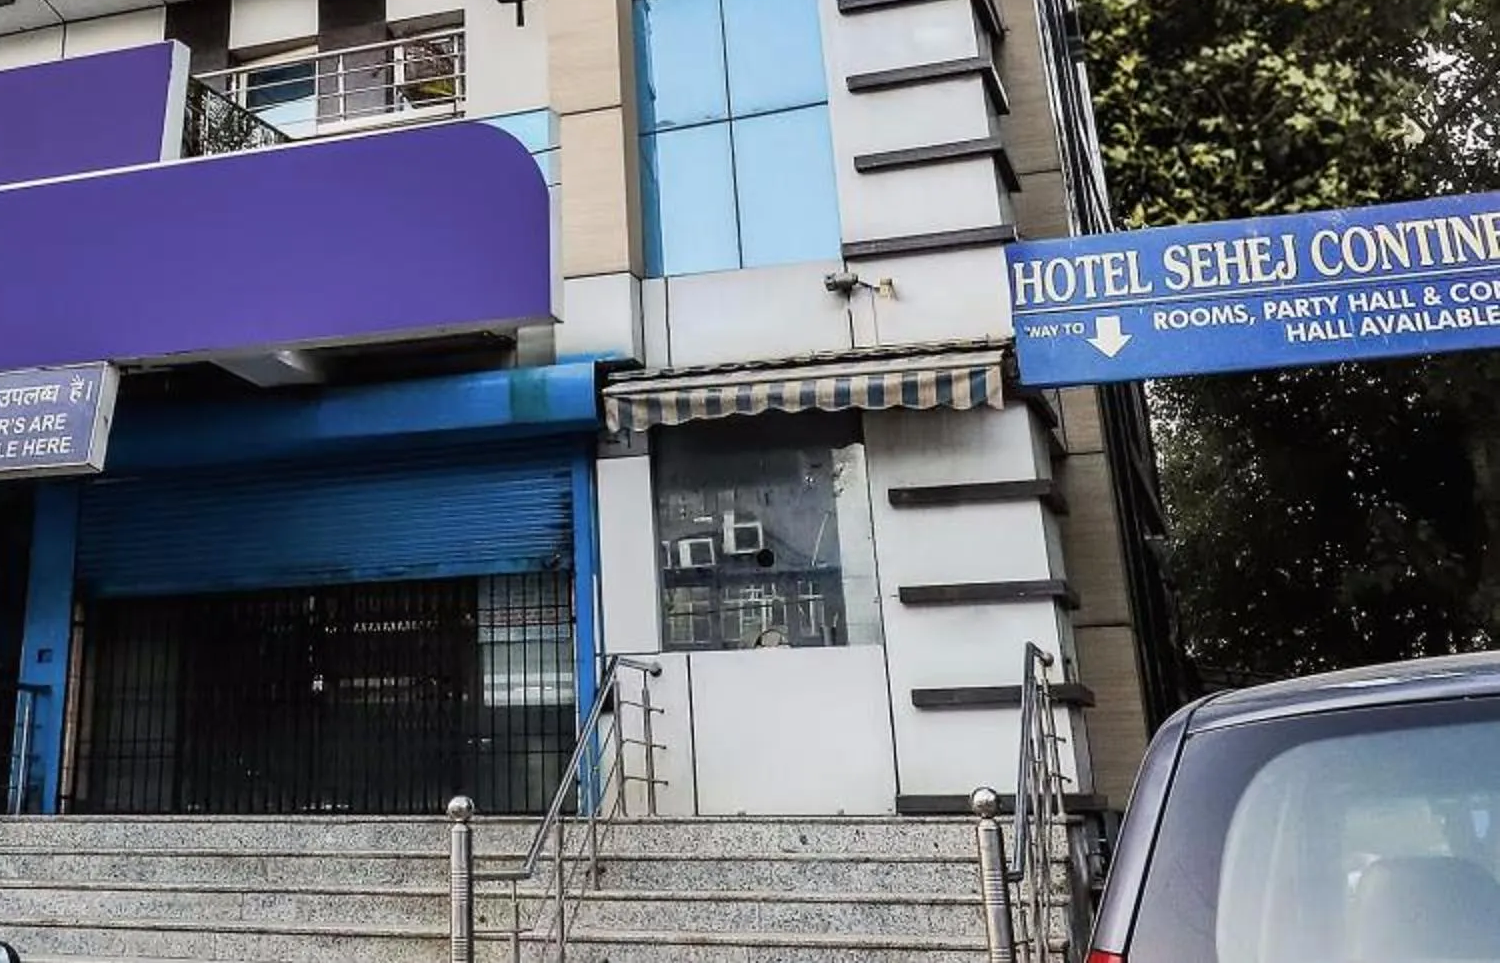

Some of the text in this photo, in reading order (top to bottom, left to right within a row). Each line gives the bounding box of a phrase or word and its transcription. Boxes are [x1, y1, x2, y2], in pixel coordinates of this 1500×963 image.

[1013, 250, 1153, 306] HOTEL
[1163, 233, 1297, 290] SEHEJ
[1153, 304, 1256, 330] ROOMS,
[1263, 295, 1339, 320] PARTY
[1347, 288, 1416, 313] HALL
[1423, 286, 1443, 305] &
[1062, 322, 1084, 334] TO
[1286, 304, 1500, 343] HALL AVAILABLE
[29, 413, 68, 432] ARE
[21, 436, 73, 455] HERE
